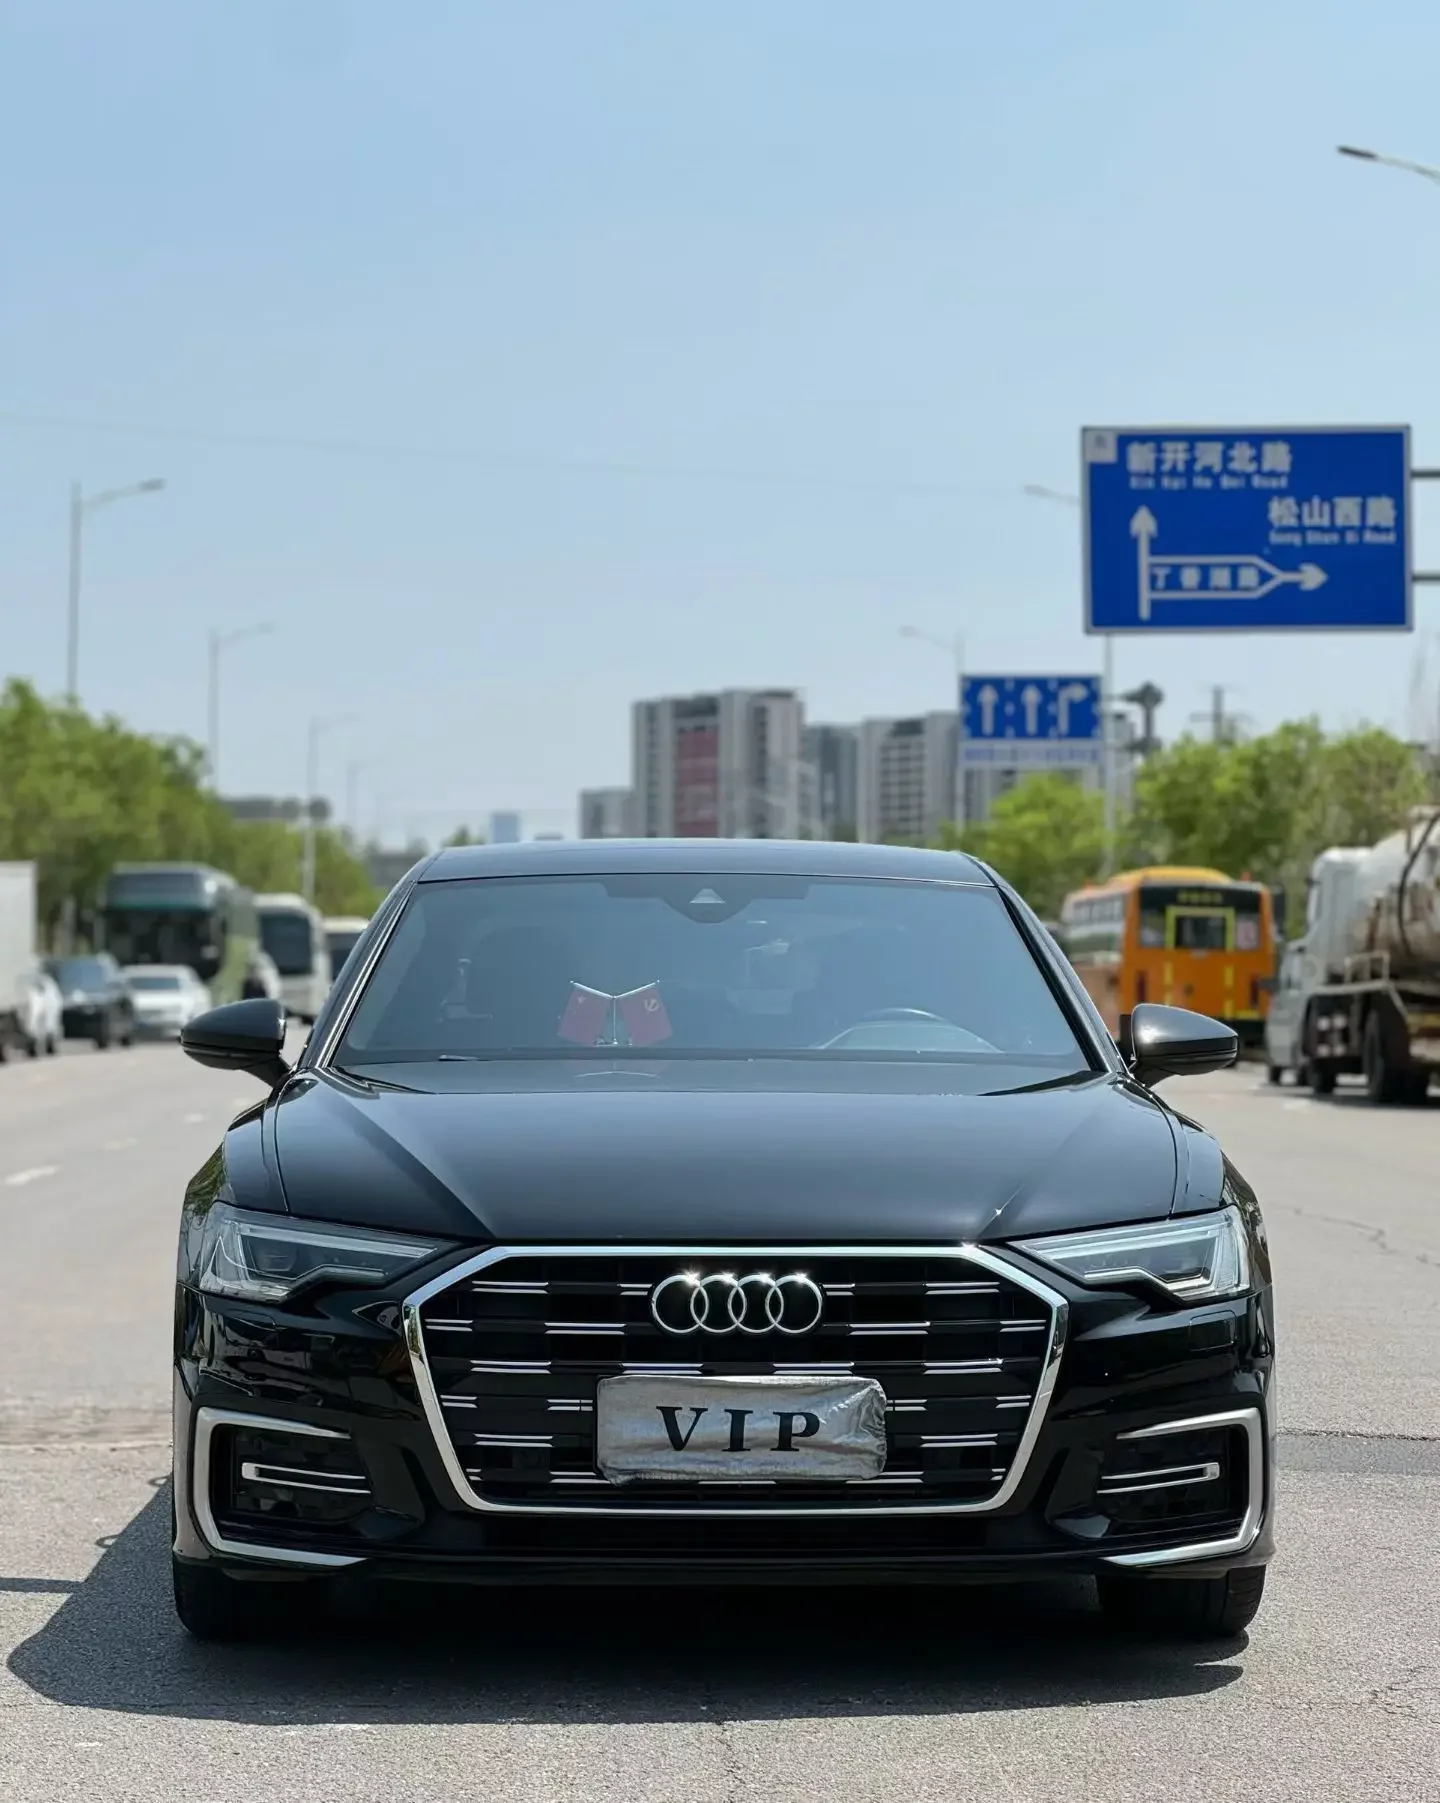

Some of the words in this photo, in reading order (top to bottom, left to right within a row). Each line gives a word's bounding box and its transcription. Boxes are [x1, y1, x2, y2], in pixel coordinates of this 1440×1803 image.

[1127, 441, 1292, 474] 新开河北路
[1268, 495, 1397, 528] 松山西路
[656, 1406, 821, 1452] VIP
